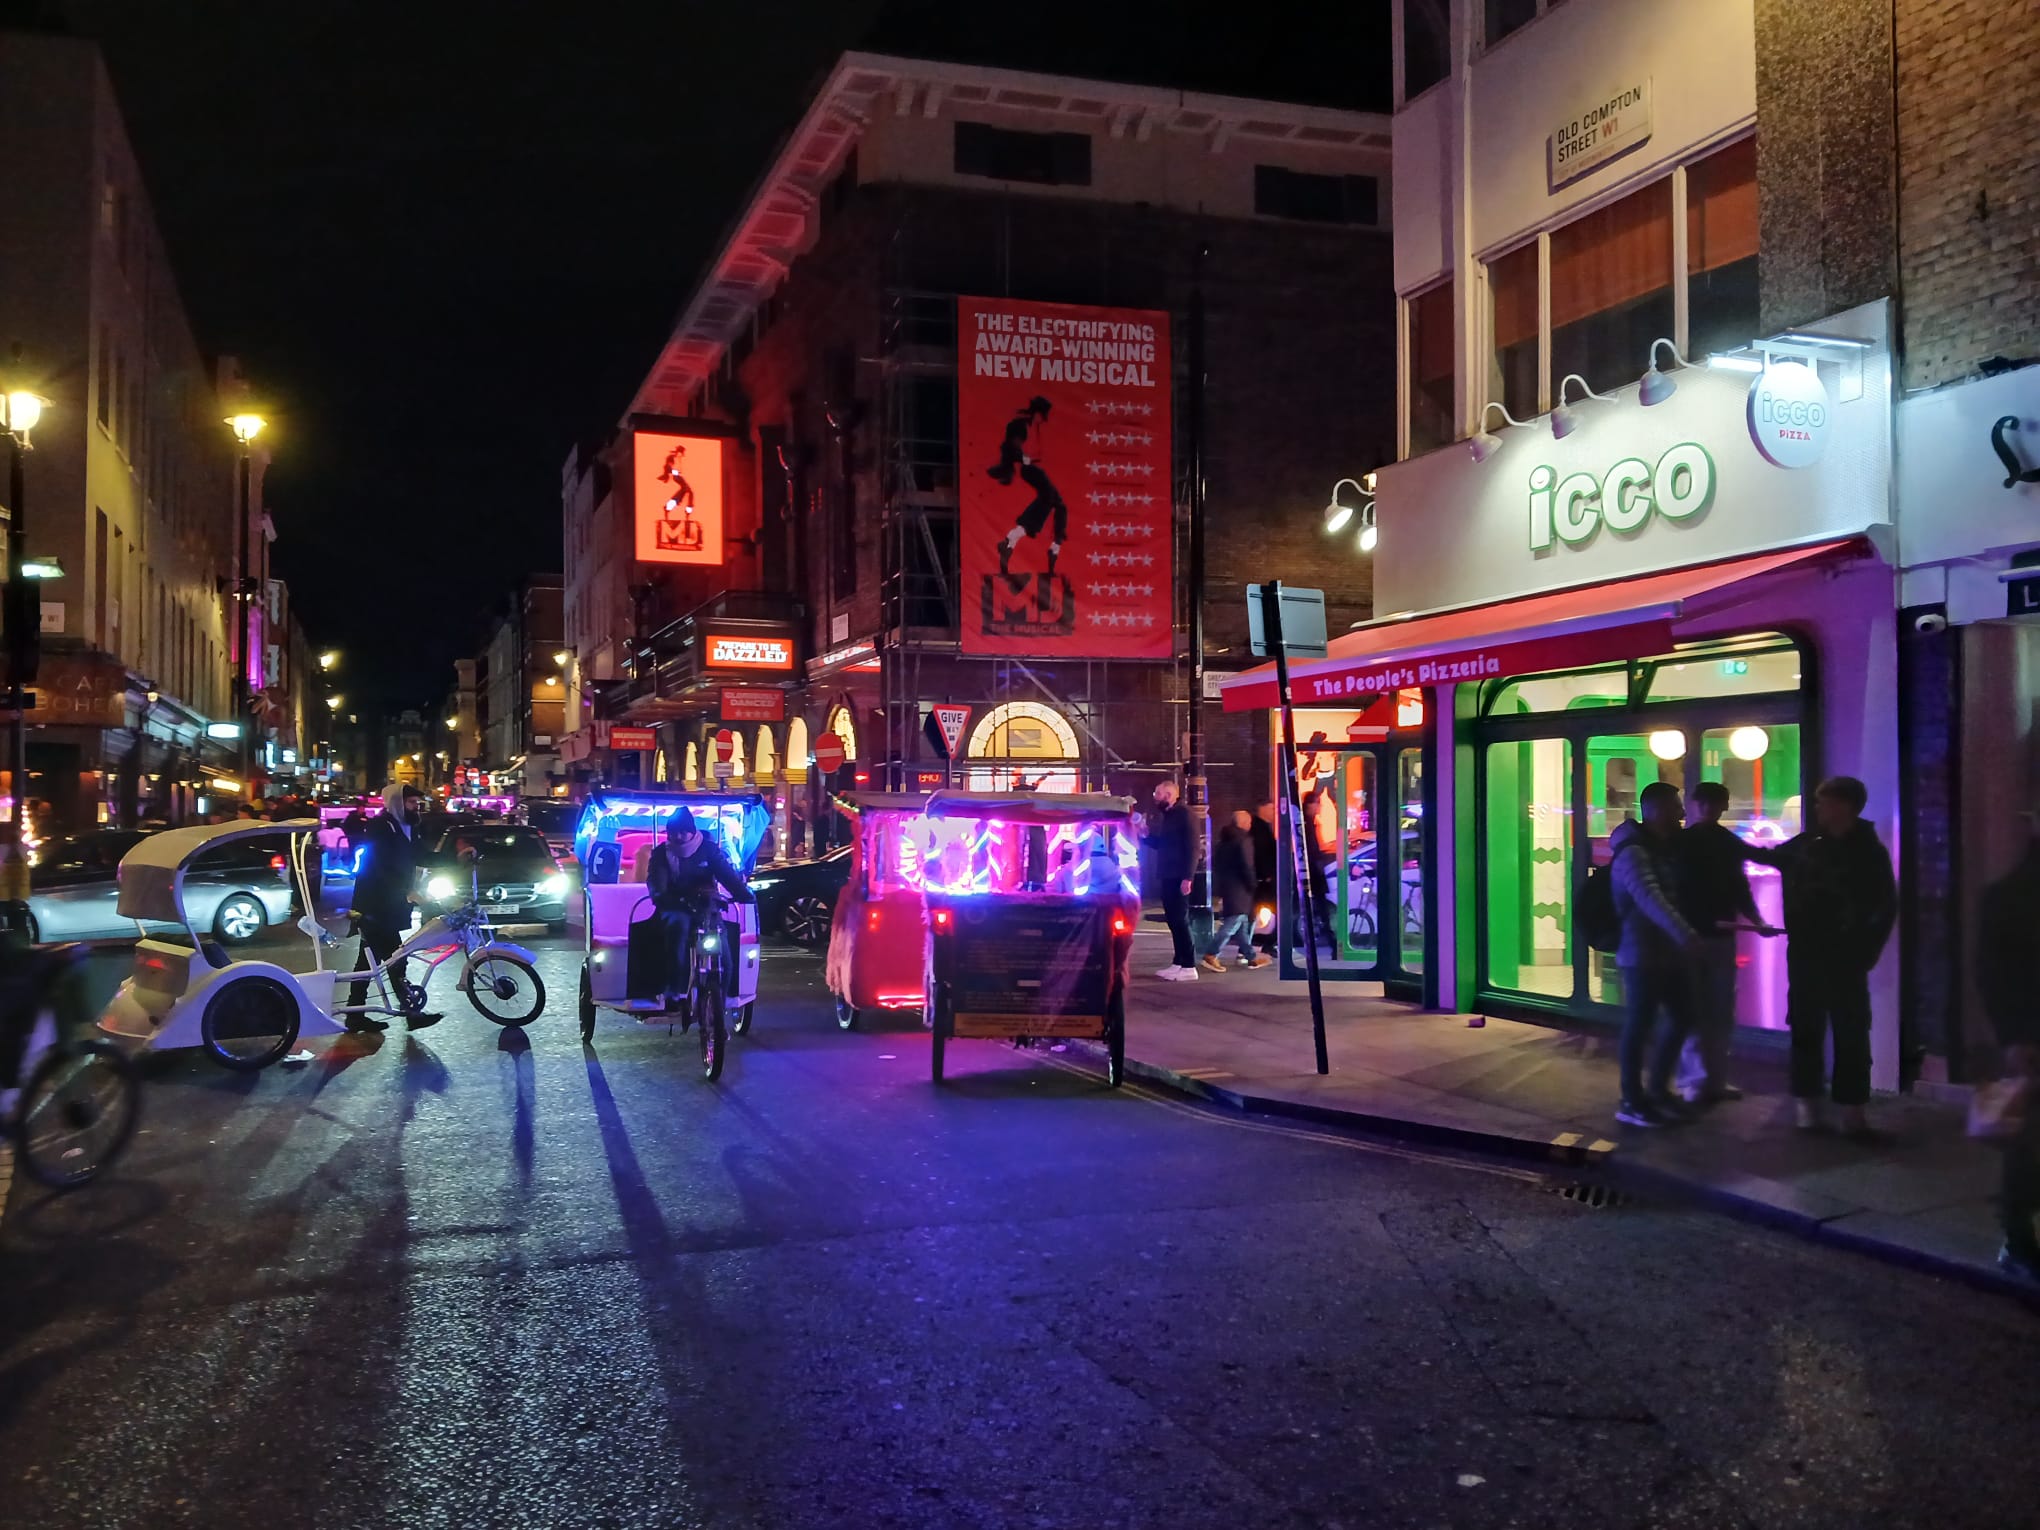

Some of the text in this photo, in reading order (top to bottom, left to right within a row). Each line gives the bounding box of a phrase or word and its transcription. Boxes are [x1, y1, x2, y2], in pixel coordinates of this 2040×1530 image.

[1558, 86, 1642, 144] OLD COMPTON
[1558, 129, 1598, 163] STREET
[1602, 117, 1619, 138] W1
[975, 313, 1155, 342] THE ELECTRIFYING
[975, 332, 1155, 363] AWARD-WINNING
[975, 353, 1156, 387] NEW MUSICAL
[1762, 391, 1826, 428] icco
[1529, 442, 1717, 552] icco
[1313, 654, 1500, 696] The People's Pizzeria
[941, 712, 963, 724] GIVE
